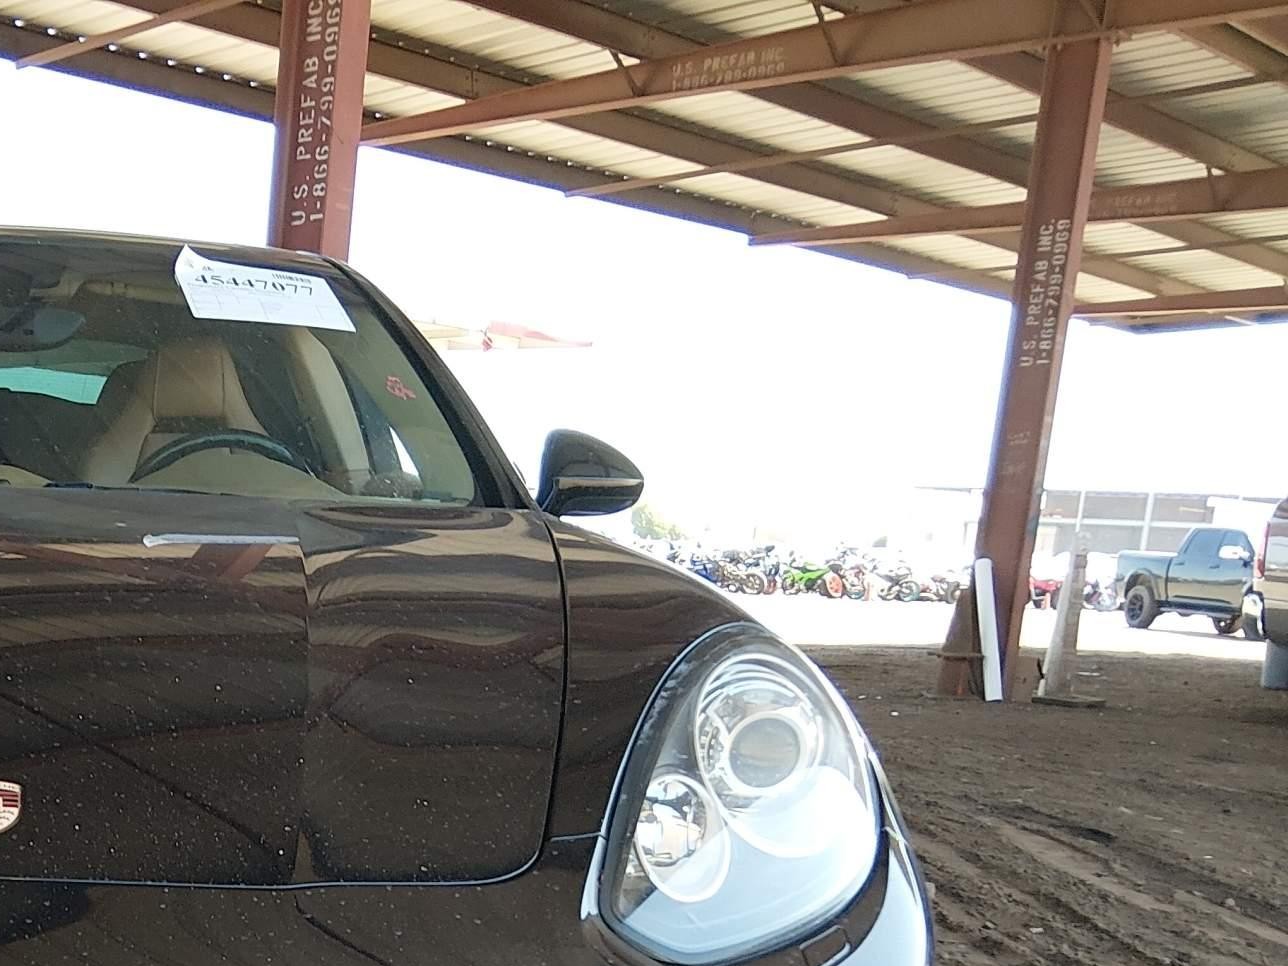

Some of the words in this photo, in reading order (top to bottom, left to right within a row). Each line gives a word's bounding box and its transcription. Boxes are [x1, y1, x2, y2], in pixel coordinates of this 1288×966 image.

[297, 56, 319, 160] PREFAB
[291, 175, 310, 226] U.S.
[194, 275, 313, 296] 45447077
[1026, 260, 1048, 325] PREFAB
[1037, 218, 1055, 252] INC.
